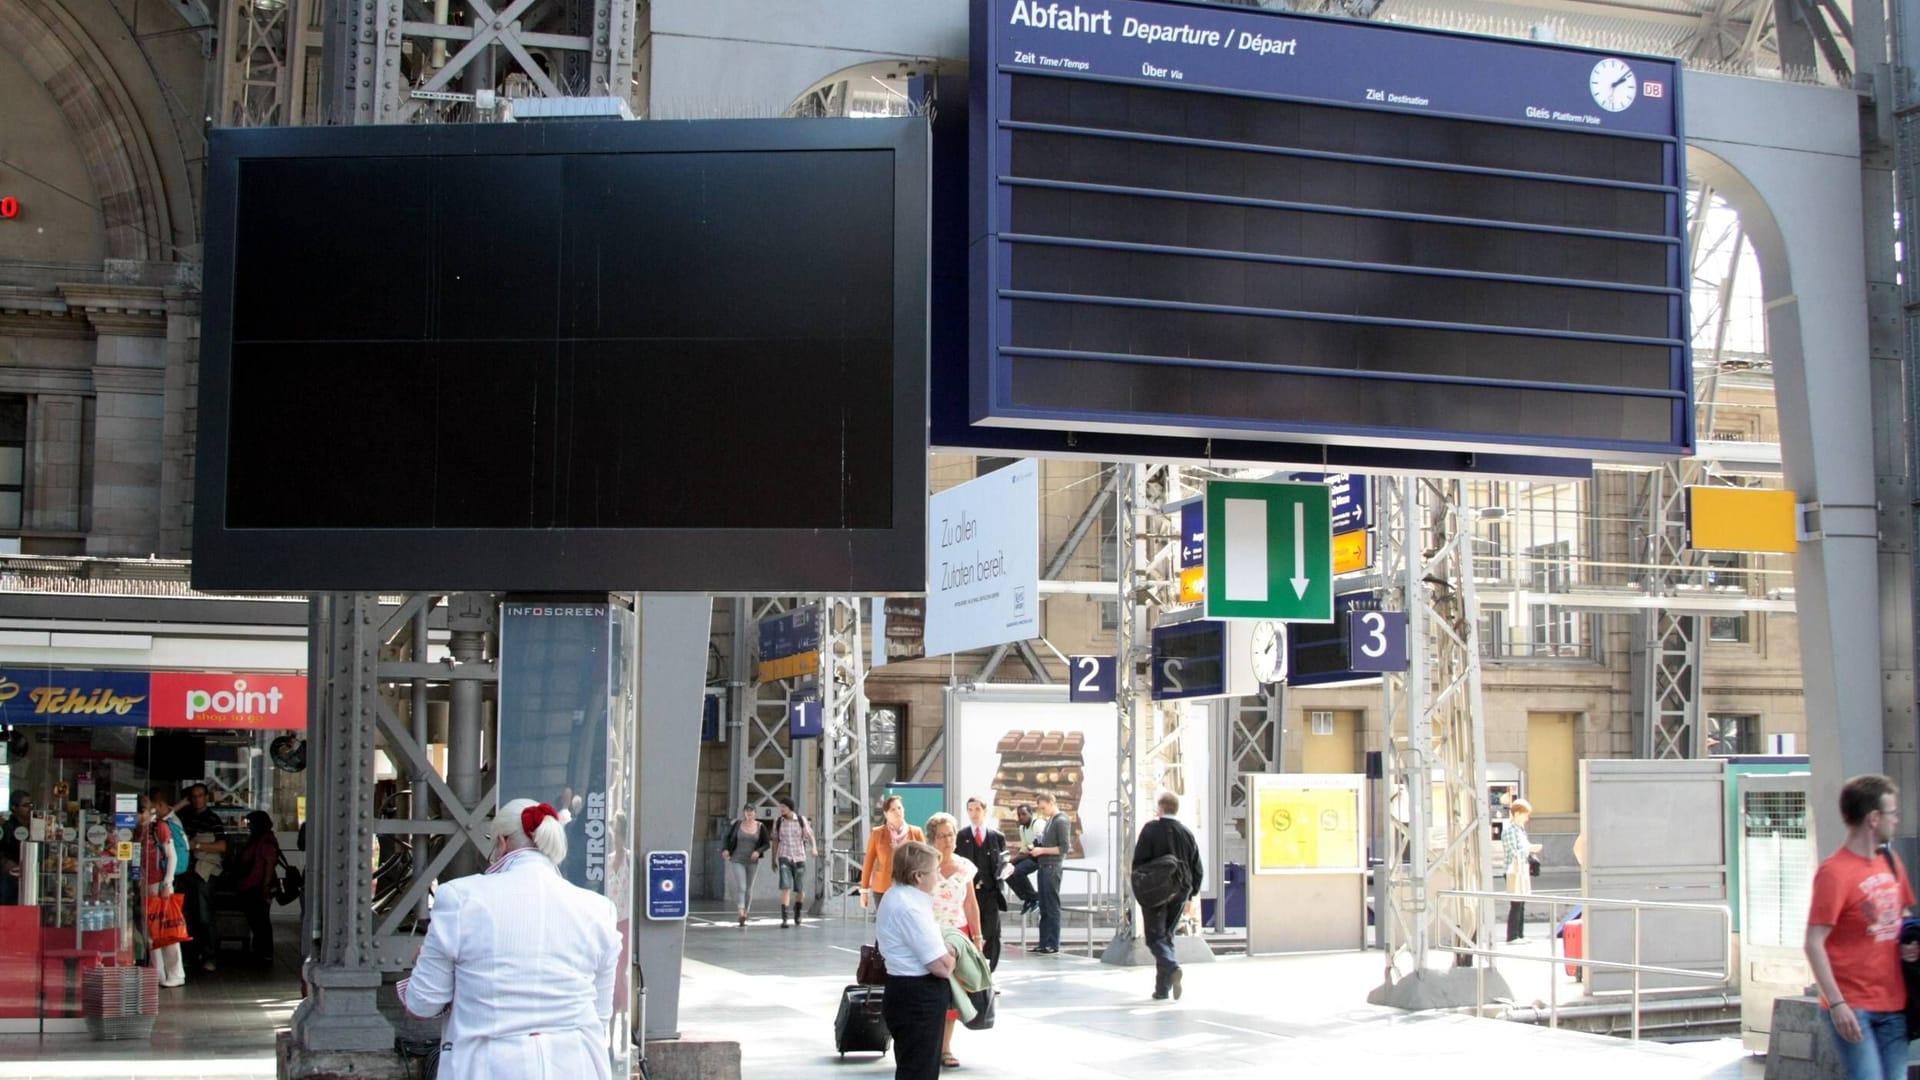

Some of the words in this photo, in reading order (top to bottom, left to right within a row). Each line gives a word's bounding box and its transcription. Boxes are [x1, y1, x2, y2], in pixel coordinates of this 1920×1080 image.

[1010, 0, 1112, 35] Abfahrt
[1122, 17, 1220, 48] Departure
[1224, 29, 1235, 49] /
[1238, 31, 1297, 57] Départ
[1014, 51, 1036, 65] Zeit
[1039, 56, 1090, 71] Time/Temps
[1142, 62, 1167, 79] Über
[1366, 88, 1385, 102] Ziel
[1388, 93, 1429, 106] Destination
[1644, 83, 1662, 98] DB
[1526, 106, 1550, 120] Gleis
[941, 518, 953, 548] Zu
[507, 606, 605, 618] INFOSCREEN
[1361, 612, 1388, 658] 3
[1078, 658, 1100, 692] 2
[29, 687, 146, 716] Tchibo
[186, 679, 284, 721] point
[196, 713, 226, 722] shop
[794, 702, 807, 728] 1
[585, 791, 606, 882] STRÖER
